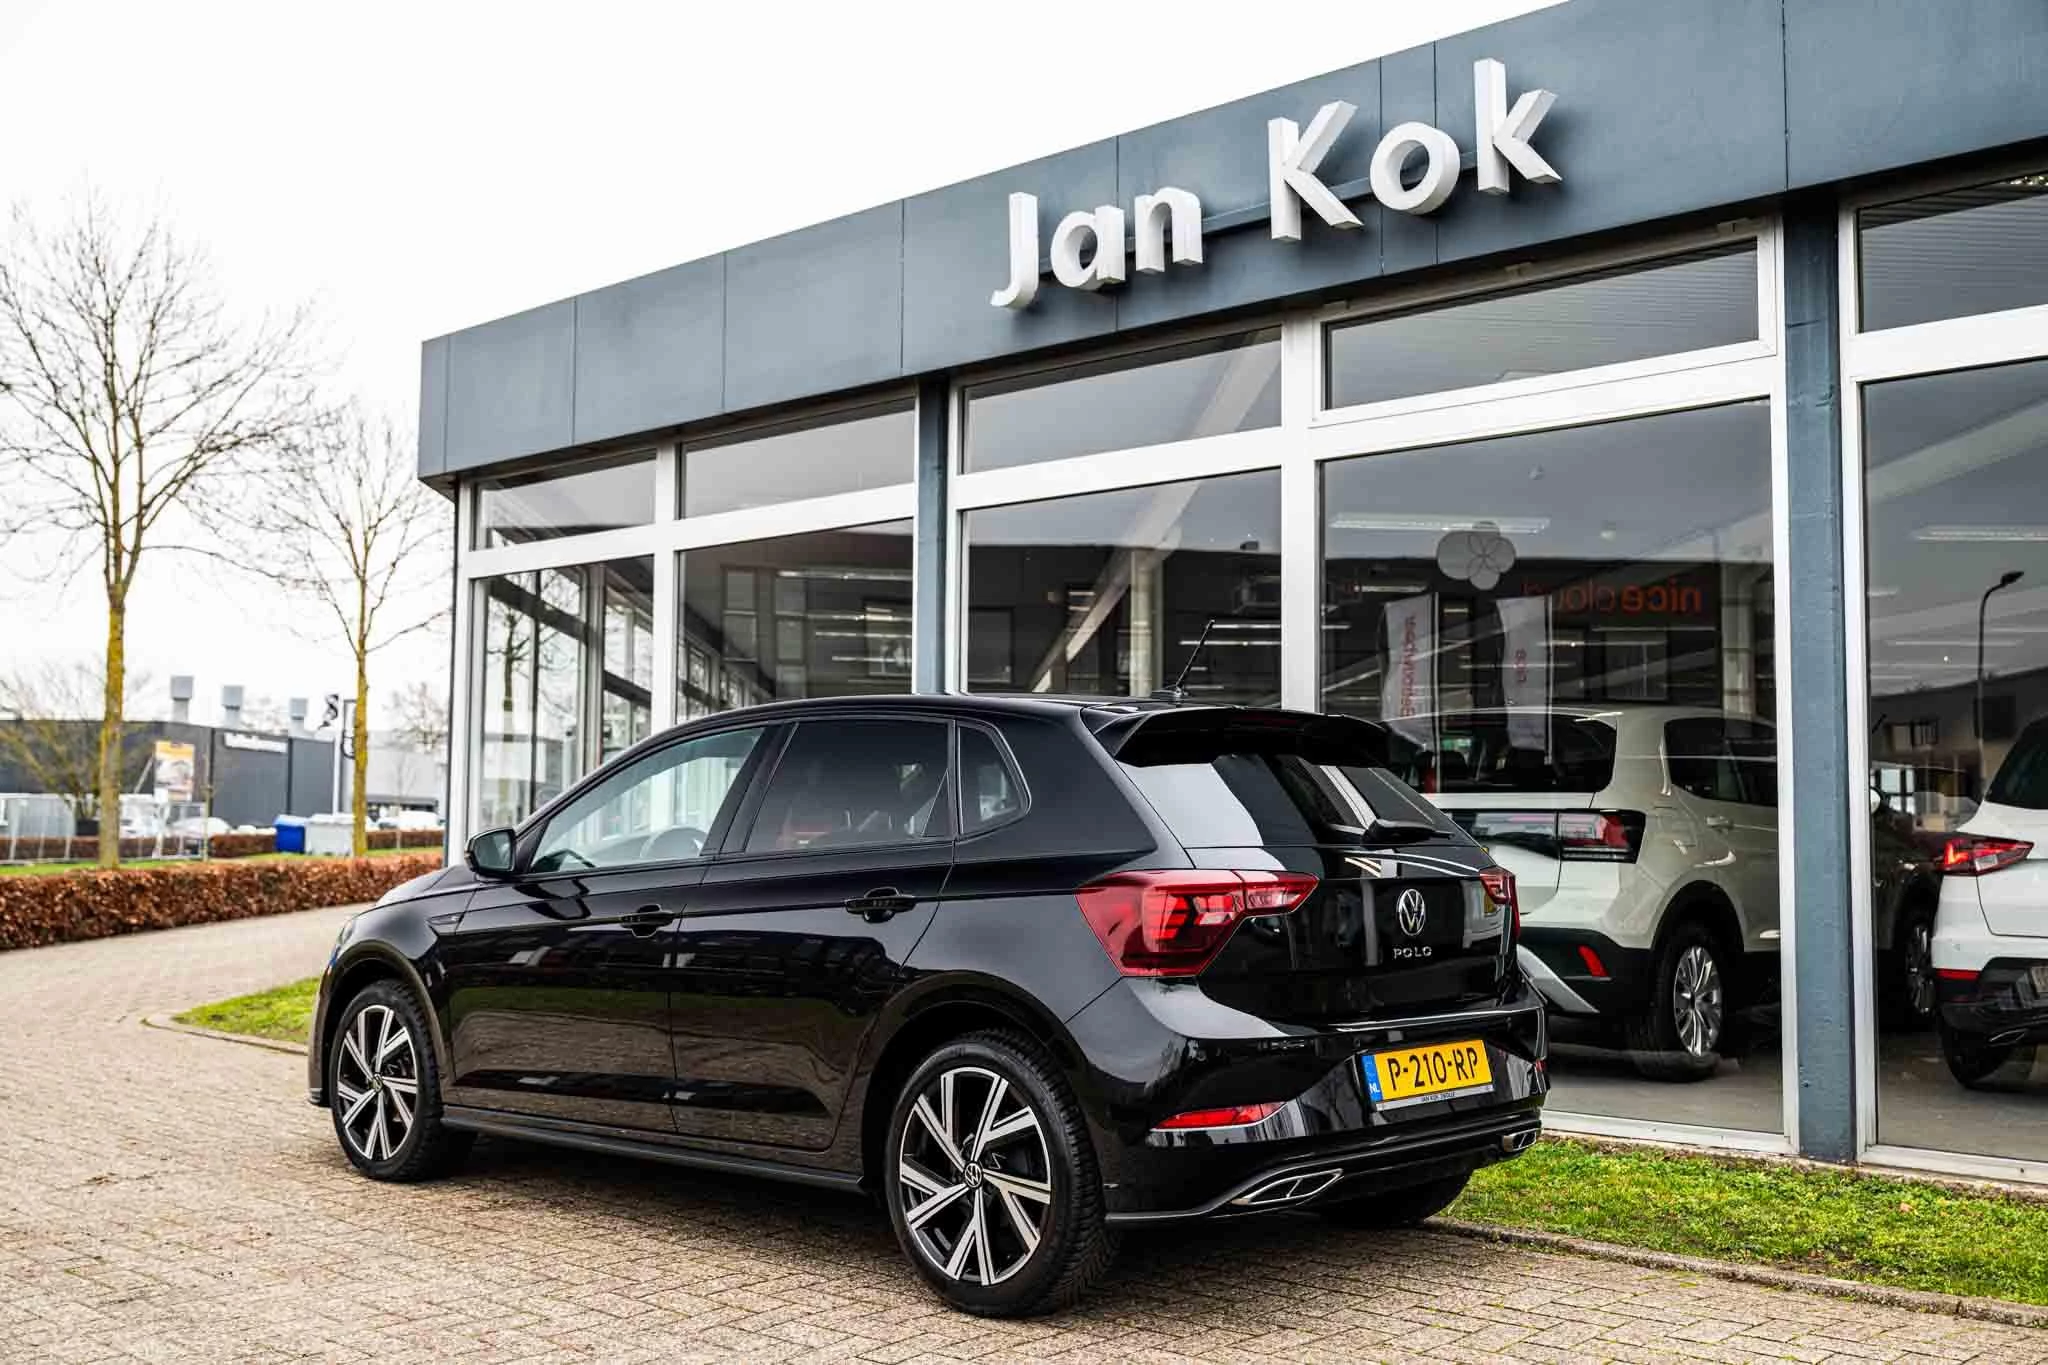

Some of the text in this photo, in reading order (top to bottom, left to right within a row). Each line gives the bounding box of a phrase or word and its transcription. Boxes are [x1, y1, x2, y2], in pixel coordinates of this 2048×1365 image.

[990, 58, 1562, 311] Jan Kok
[1393, 945, 1433, 960] POLO
[1386, 1047, 1478, 1091] P-210-RP
[1368, 1083, 1381, 1094] NL
